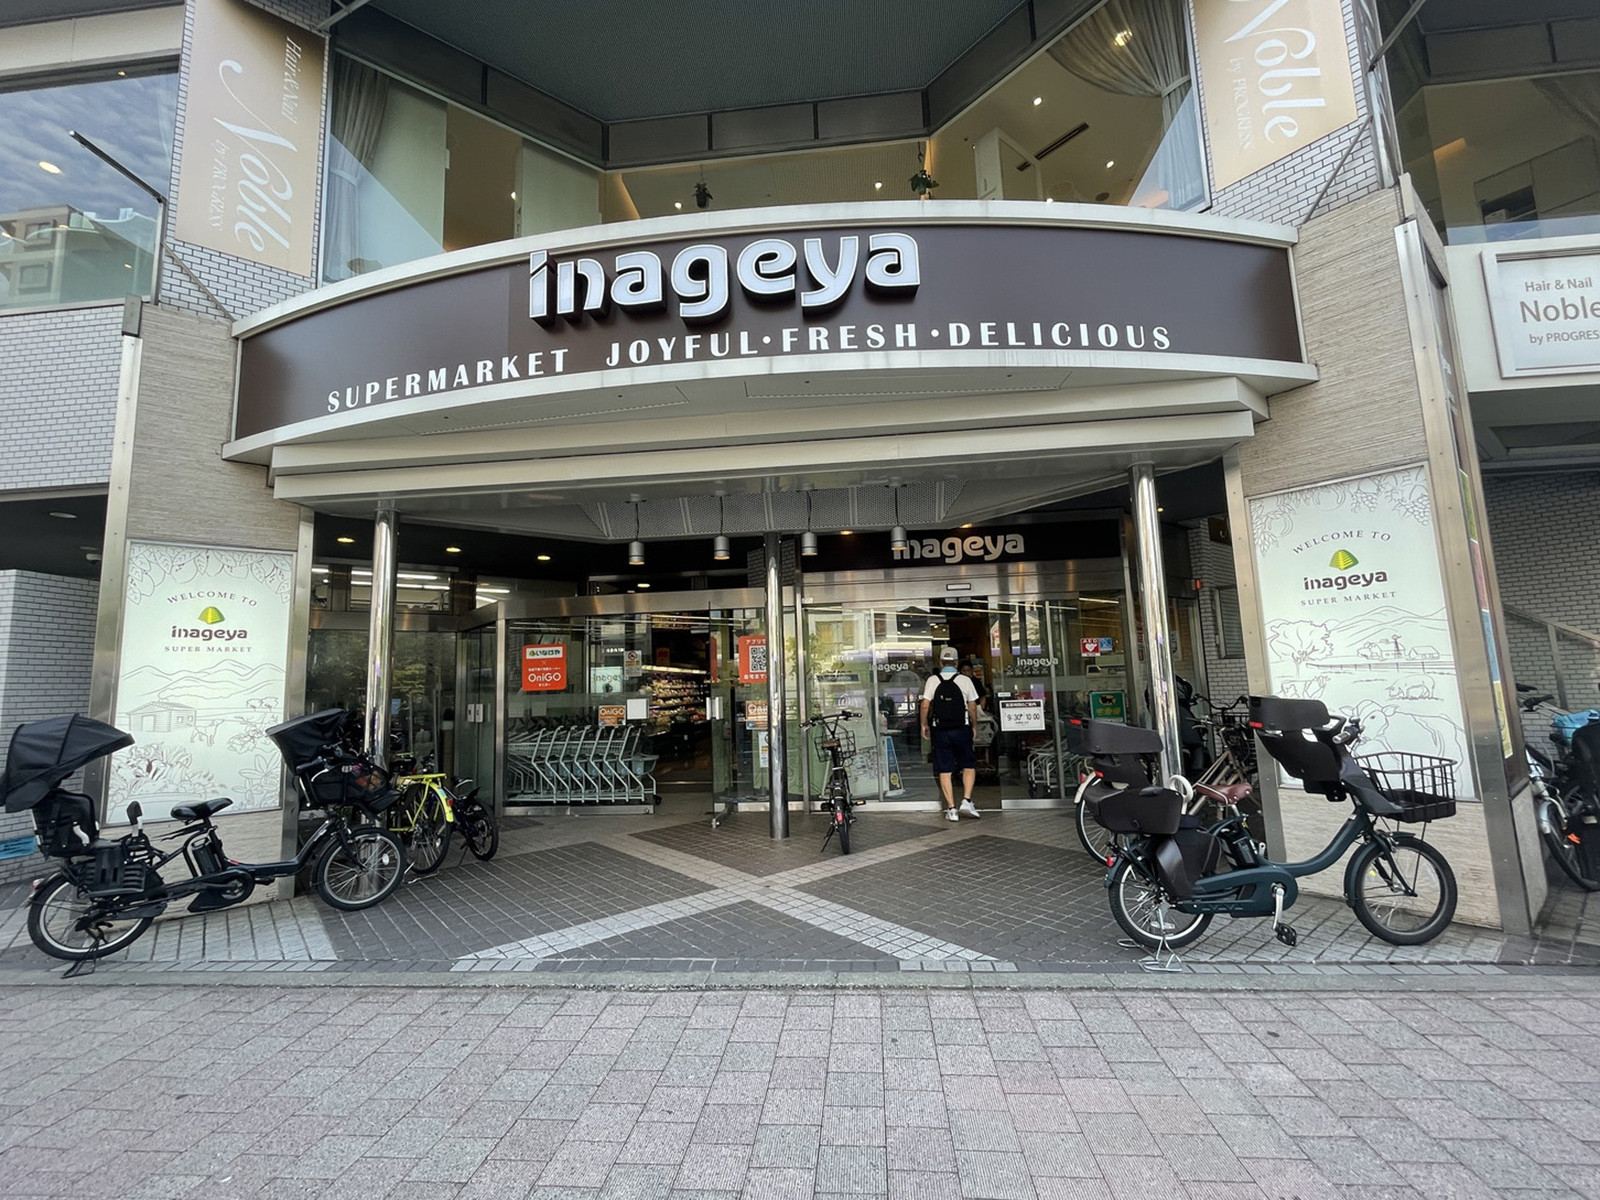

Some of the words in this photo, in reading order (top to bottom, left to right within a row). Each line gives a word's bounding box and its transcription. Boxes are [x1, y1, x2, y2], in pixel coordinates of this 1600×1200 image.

[285, 36, 302, 75] Hair
[282, 87, 299, 125] Nail
[213, 59, 298, 252] Noble
[529, 232, 921, 319] inageya
[1525, 281, 1551, 292] Hair
[1554, 279, 1564, 290] &
[1567, 277, 1593, 289] Nail
[1520, 296, 1600, 323] Noble
[1529, 334, 1543, 345] by
[1546, 330, 1600, 342] PROGRES
[328, 348, 570, 412] SUPERMARKET
[1293, 530, 1364, 555] WELCOME
[1371, 531, 1392, 542] TO
[1304, 571, 1388, 591] inageya
[167, 591, 236, 604] WELCOME
[242, 596, 258, 606] TO
[1301, 597, 1338, 606] SUPER
[1344, 591, 1397, 602] MARKET
[171, 626, 248, 641] inageya
[1017, 657, 1059, 667] inageya
[528, 672, 562, 682] OniGO
